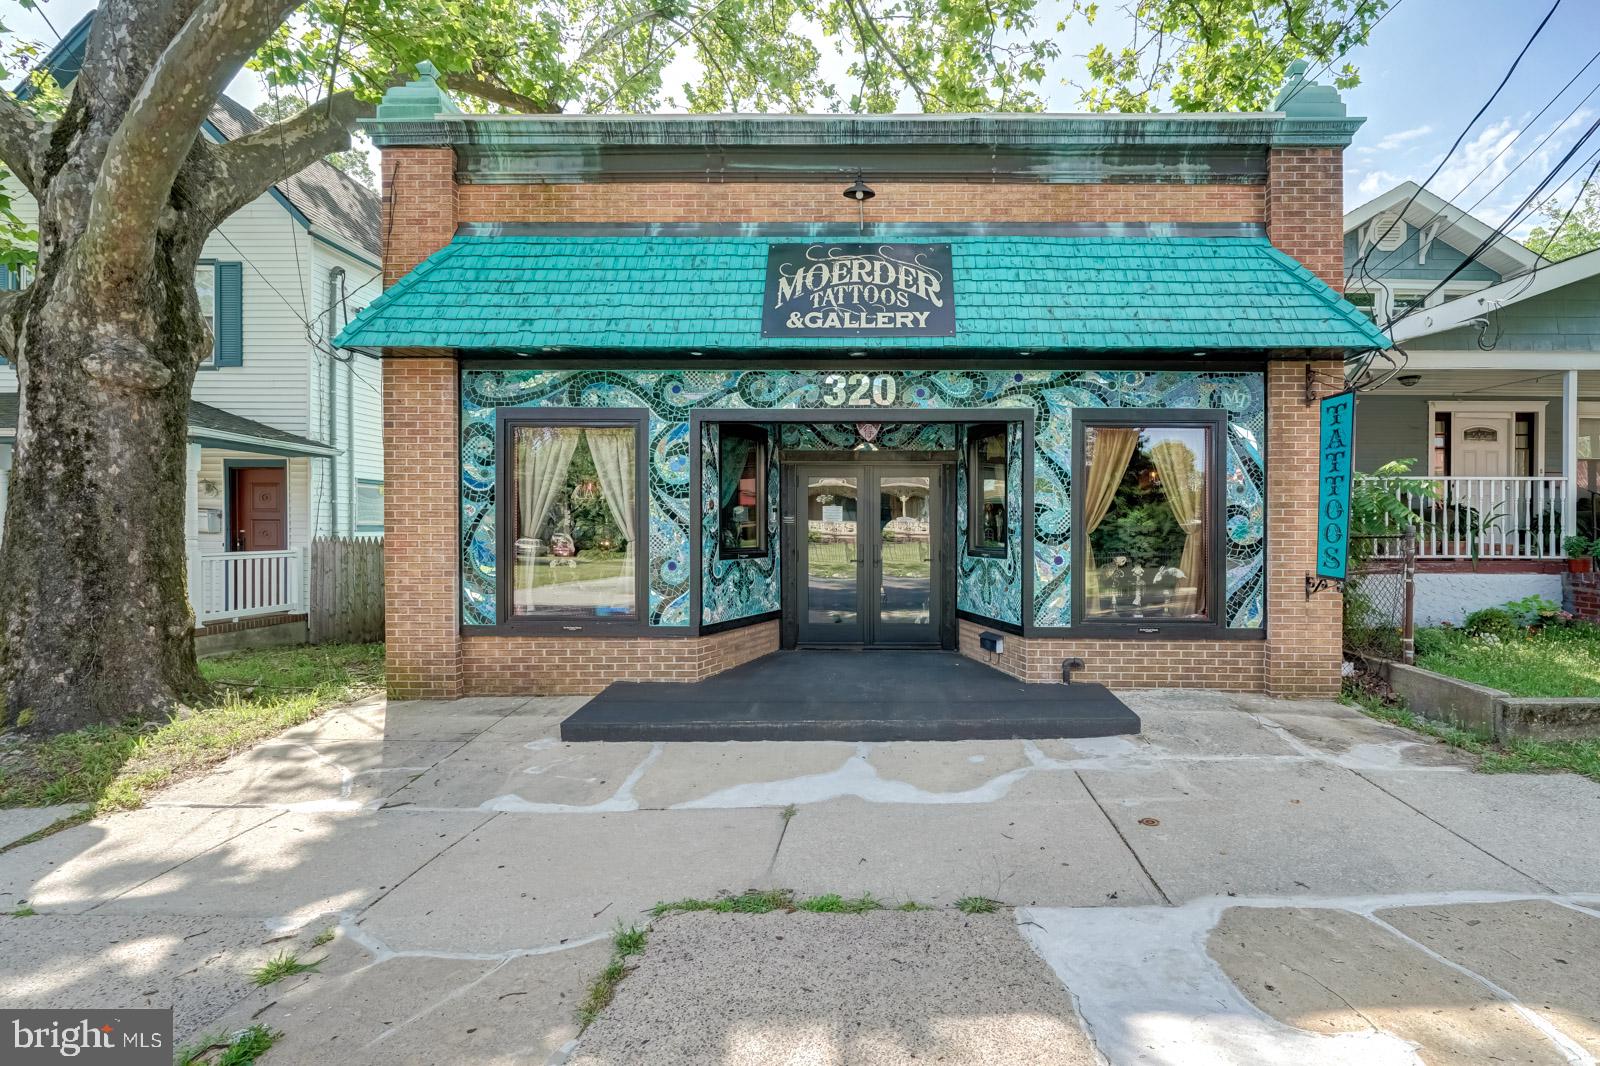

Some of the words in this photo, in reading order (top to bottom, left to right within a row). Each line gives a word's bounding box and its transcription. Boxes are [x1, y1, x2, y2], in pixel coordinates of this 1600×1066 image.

[775, 250, 944, 309] MOERDER
[809, 284, 910, 308] TATTOOS
[785, 311, 931, 329] &GALLERY
[823, 373, 897, 406] 320
[1322, 402, 1348, 570] TATTOOS
